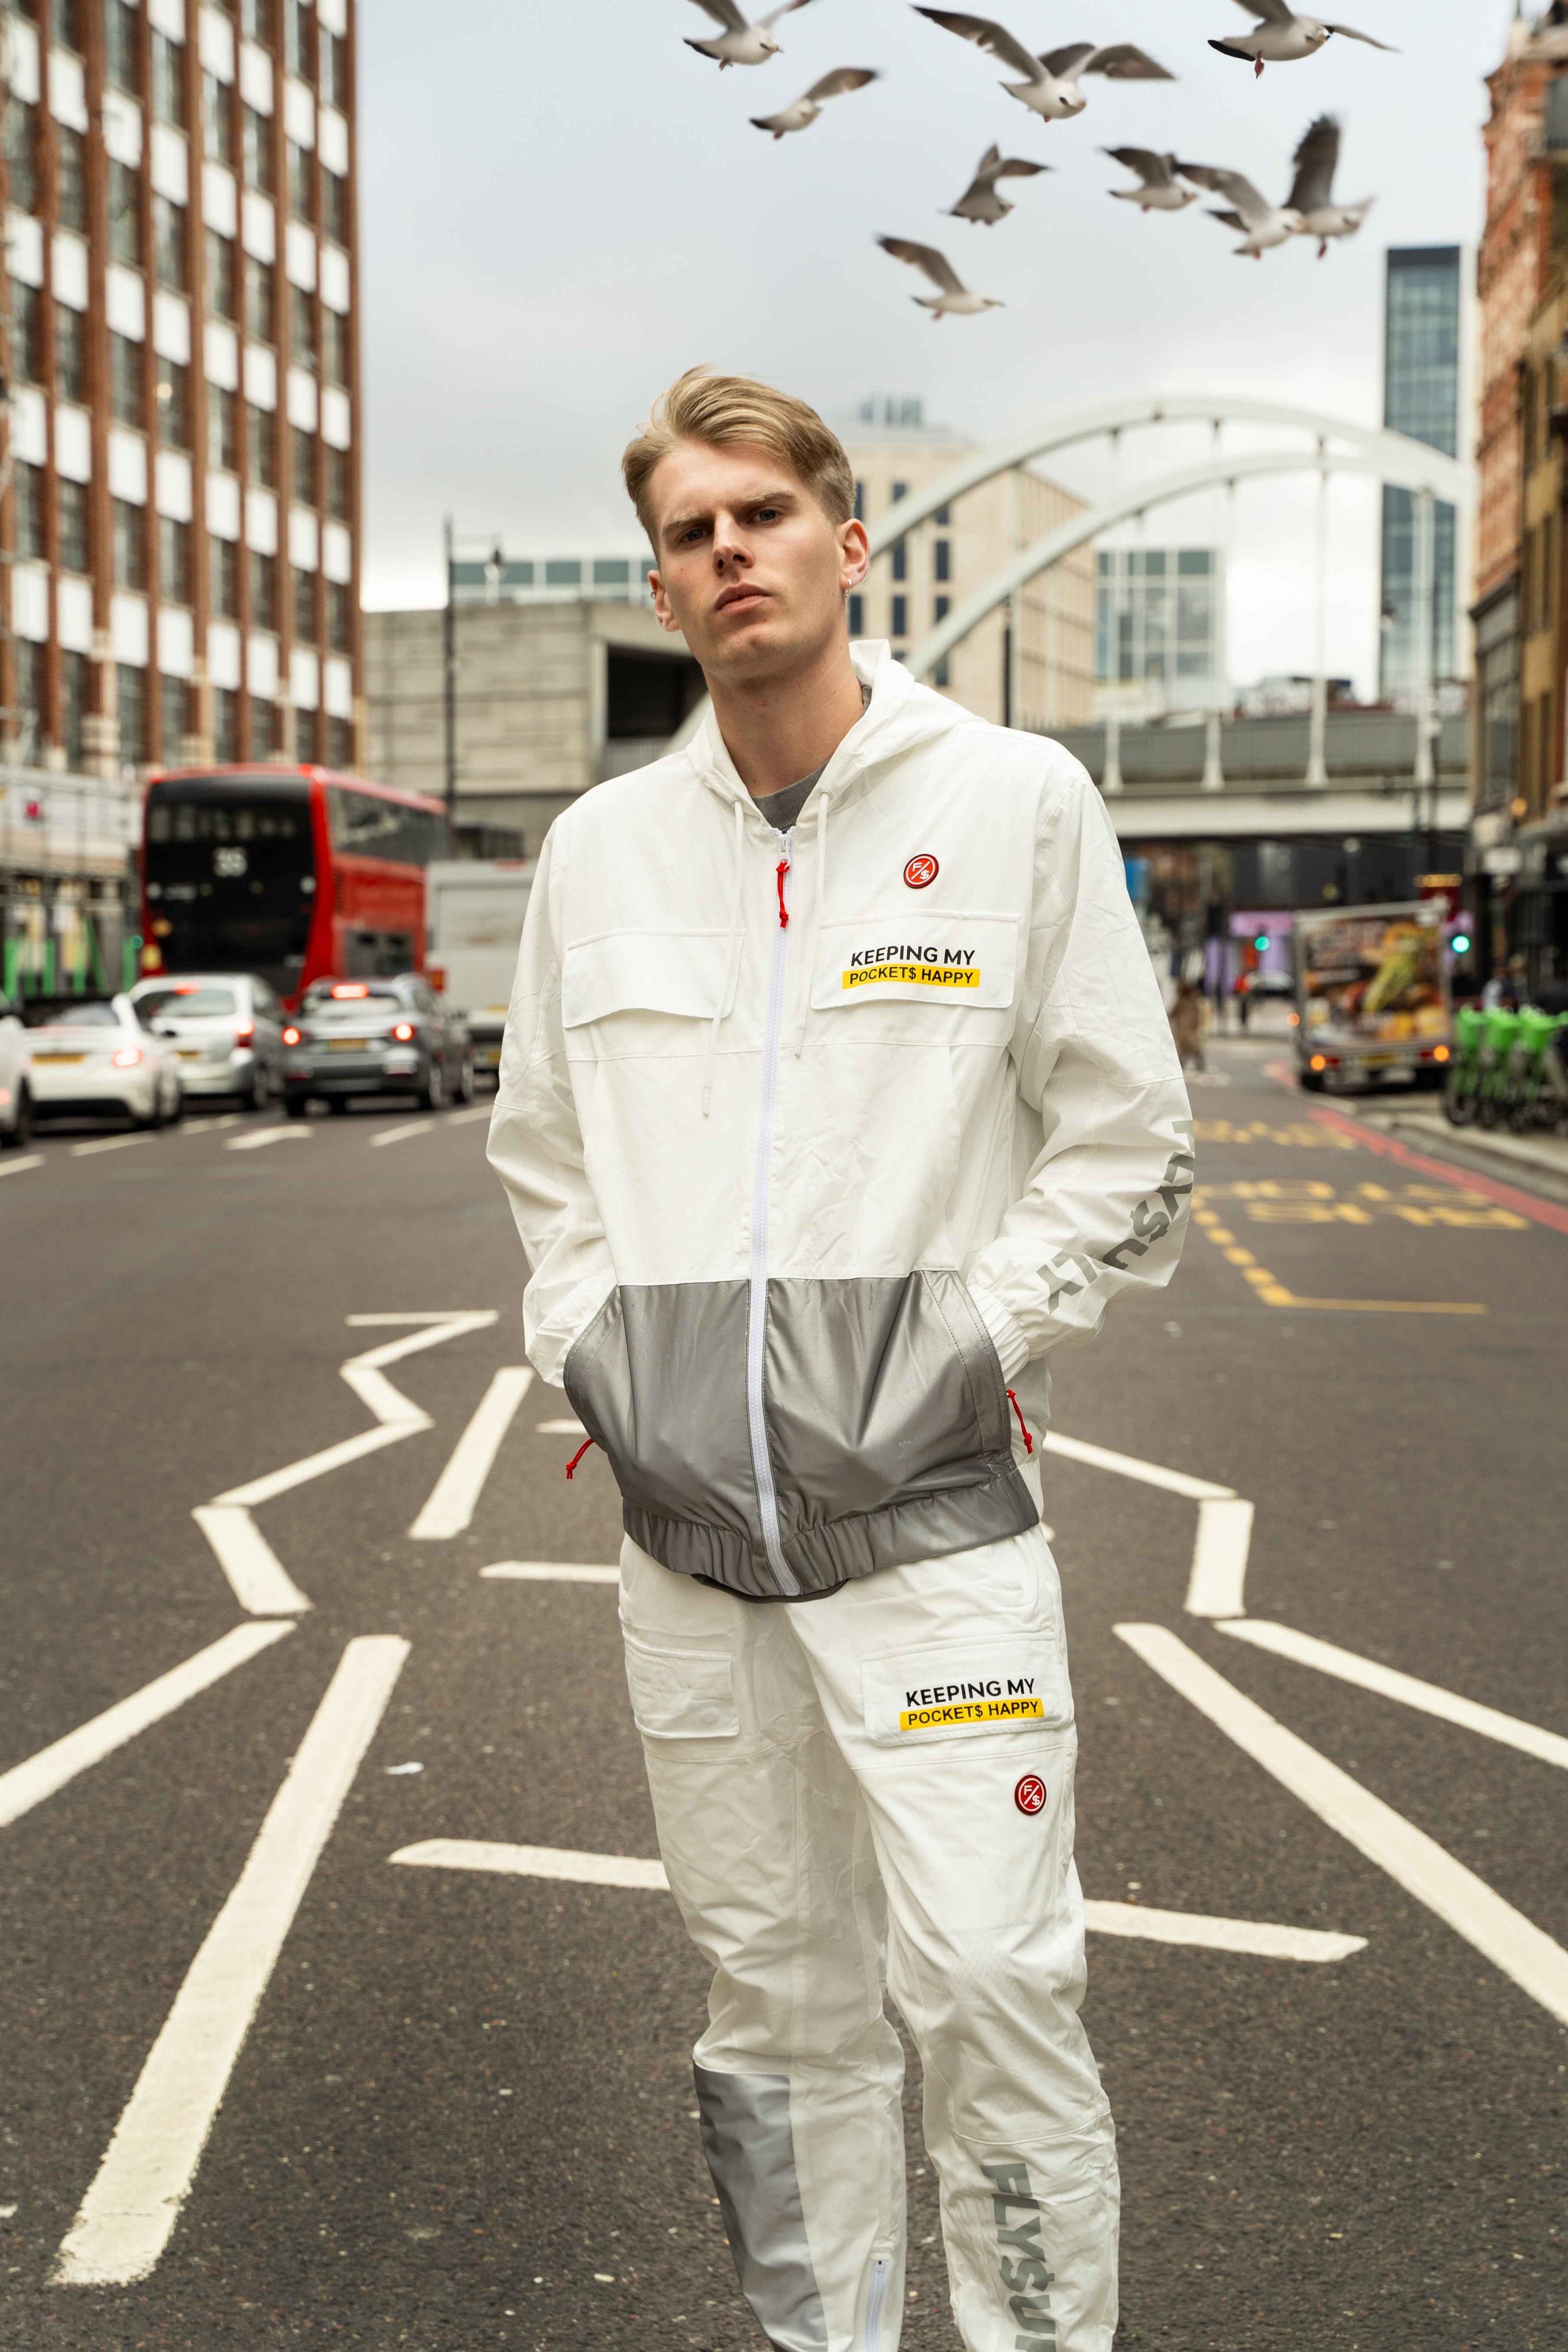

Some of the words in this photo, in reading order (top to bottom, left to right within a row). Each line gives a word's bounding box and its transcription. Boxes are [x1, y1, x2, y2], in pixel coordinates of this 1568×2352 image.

[851, 946, 937, 966] KEEPING
[944, 949, 975, 965] MY
[850, 967, 916, 984] POCKET$
[922, 968, 973, 983] HAPPY
[906, 1681, 1001, 1707] KEEPING
[1007, 1678, 1034, 1695] MY
[908, 1705, 983, 1725] POCKET$
[988, 1701, 1038, 1715] HAPPY
